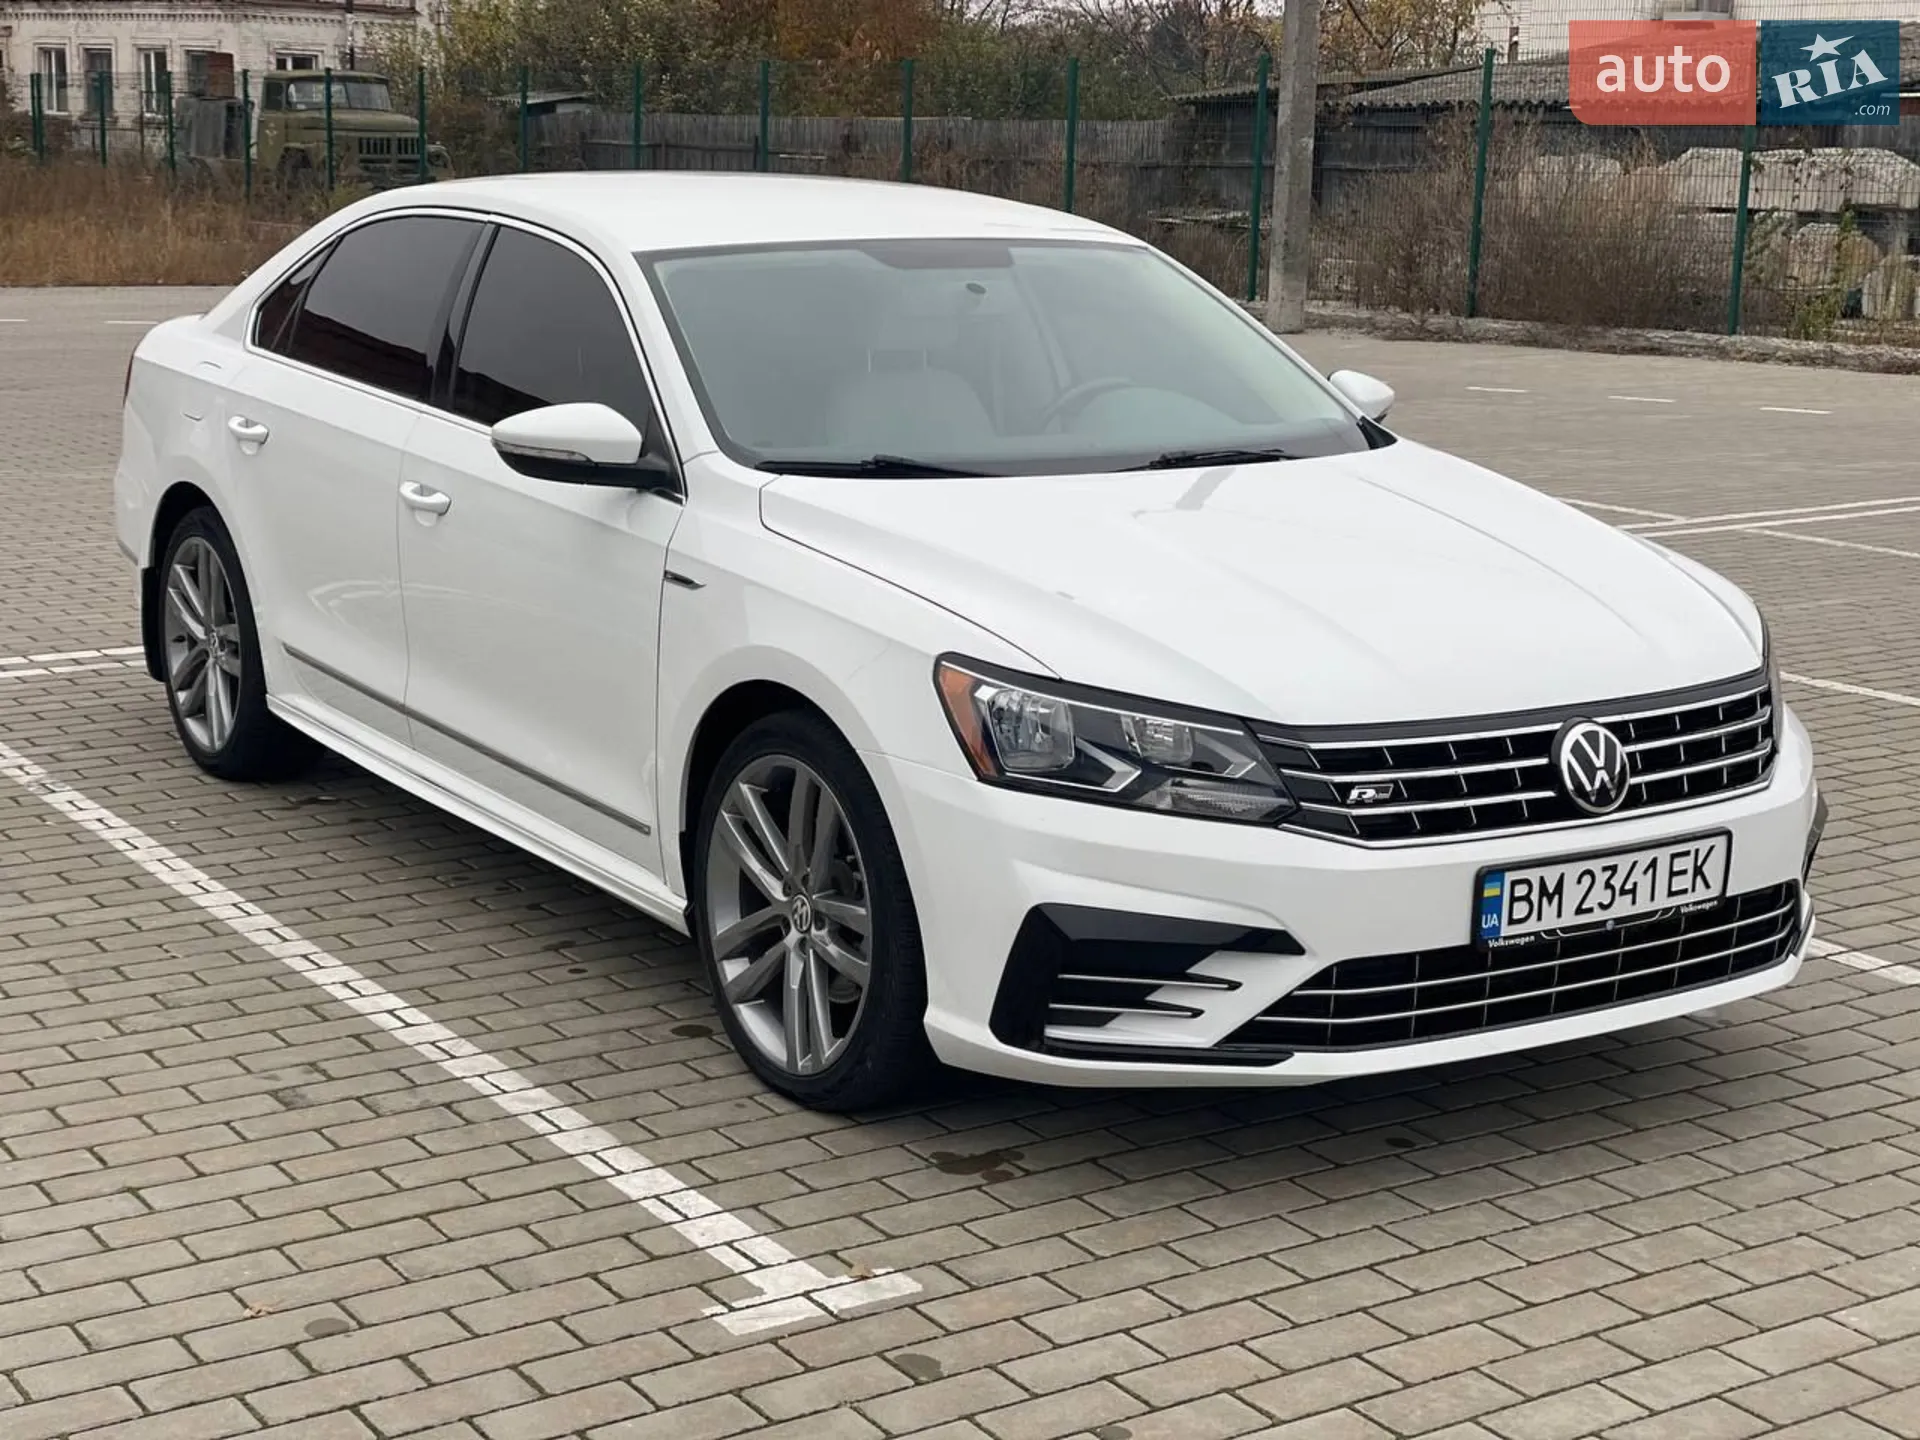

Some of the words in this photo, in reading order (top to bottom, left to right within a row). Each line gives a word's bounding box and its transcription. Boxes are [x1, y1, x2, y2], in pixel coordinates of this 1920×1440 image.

[1507, 871, 1565, 926] BM
[1574, 855, 1659, 917] 2341
[1666, 844, 1717, 898] EK
[1481, 913, 1500, 929] UA
[1487, 935, 1536, 949] Volkswagen
